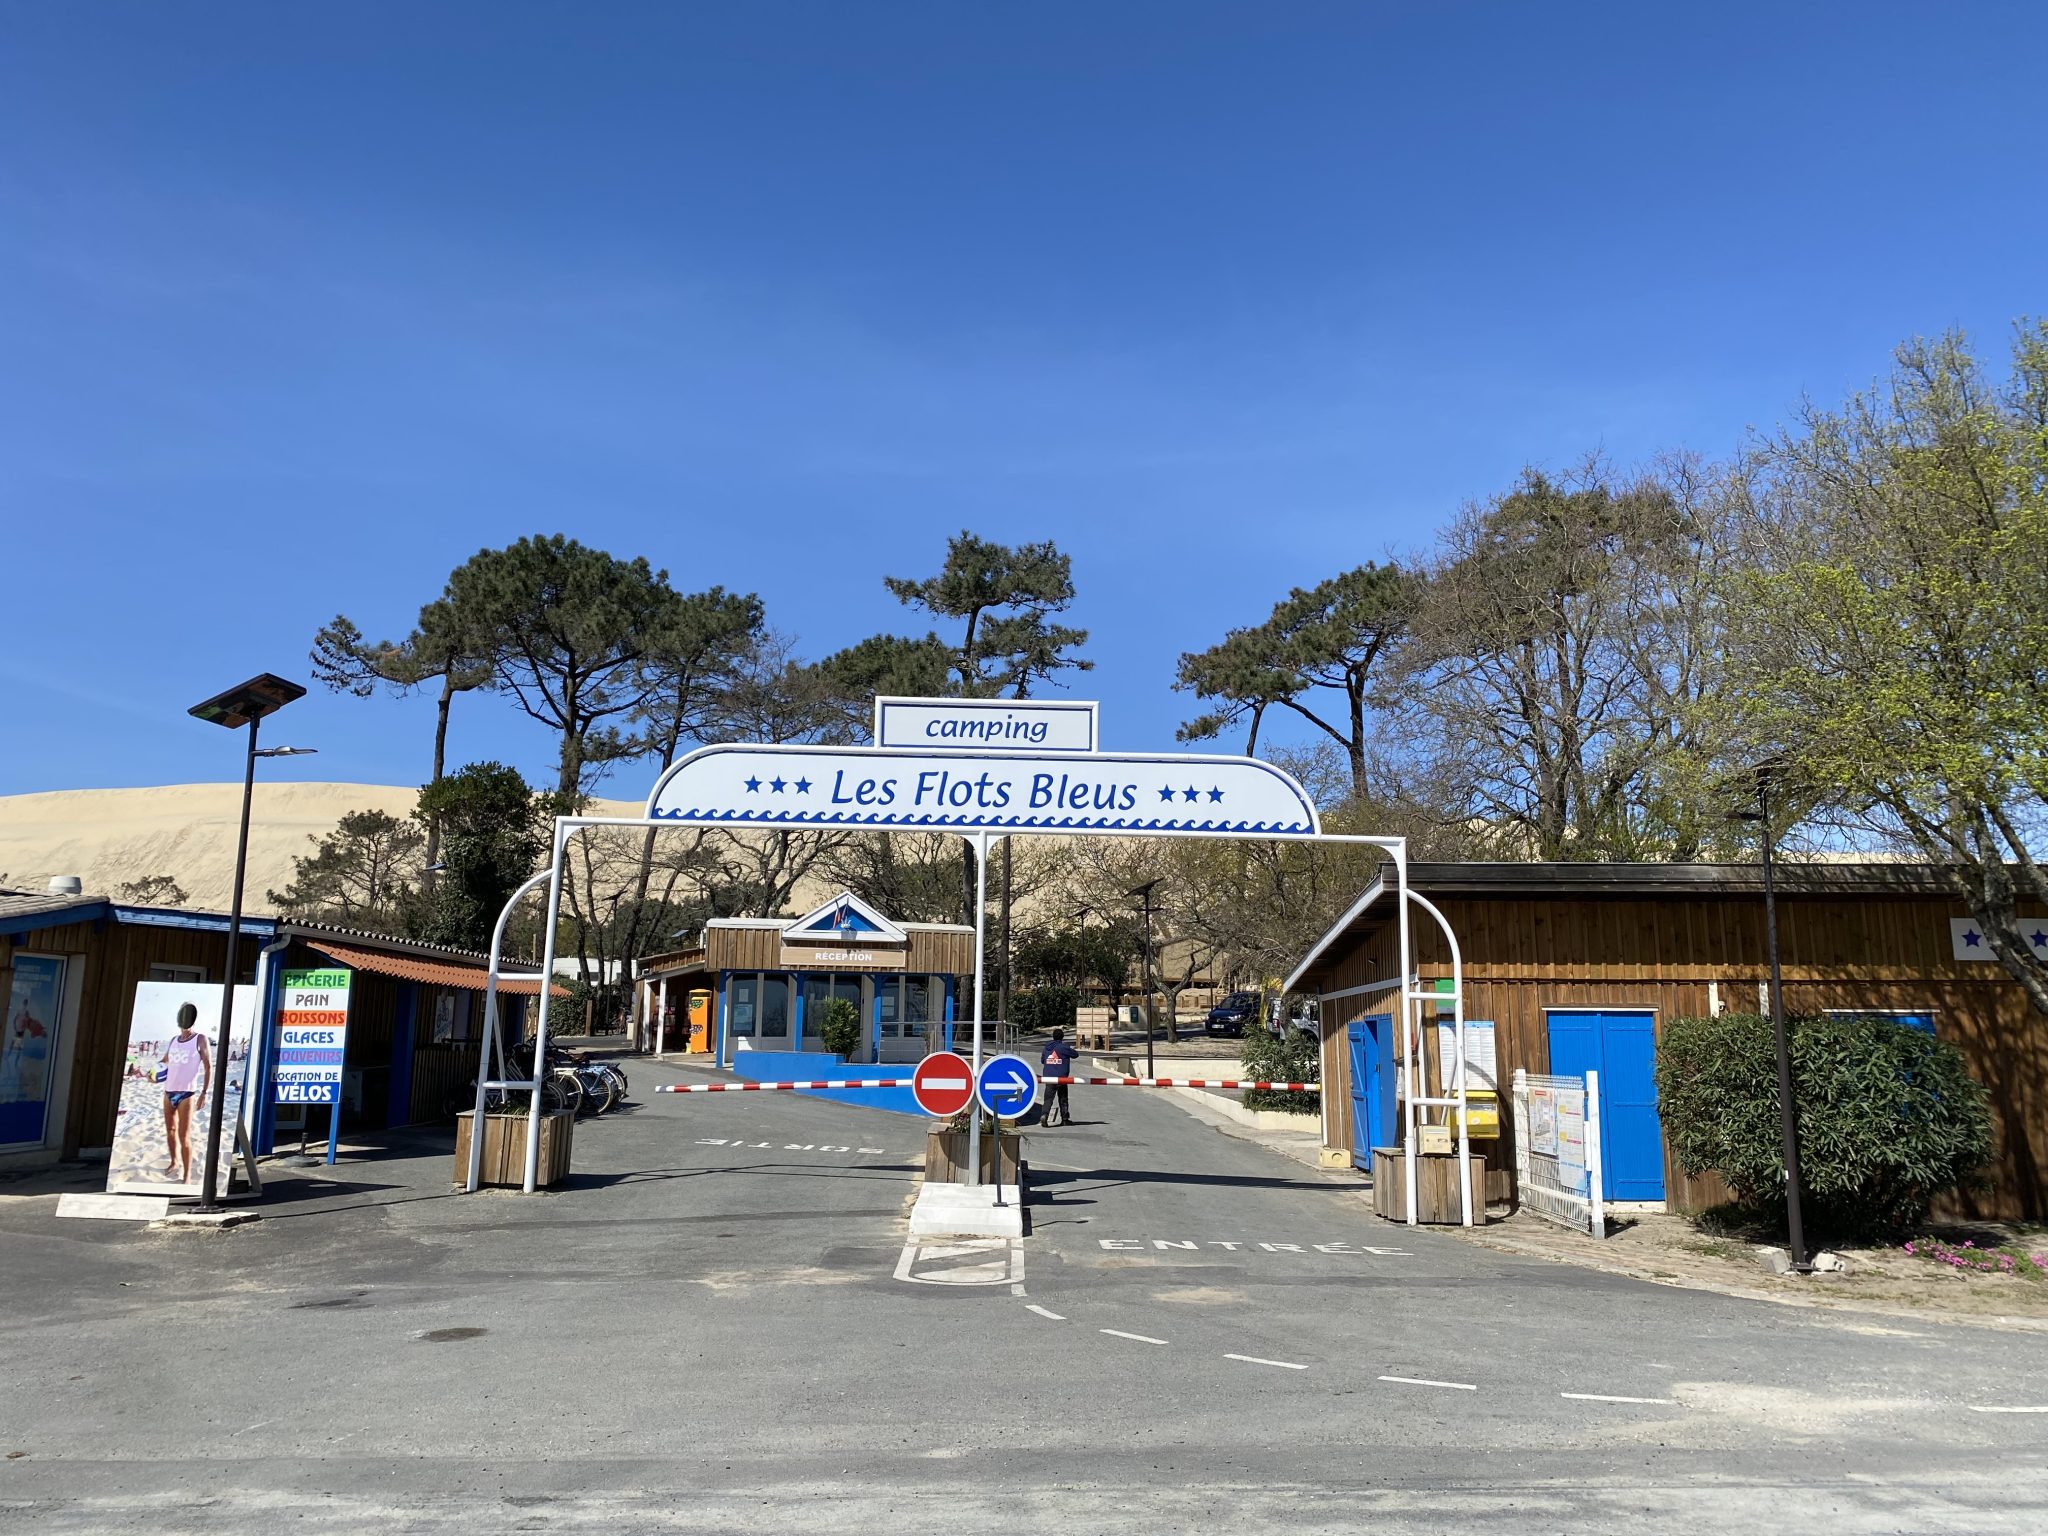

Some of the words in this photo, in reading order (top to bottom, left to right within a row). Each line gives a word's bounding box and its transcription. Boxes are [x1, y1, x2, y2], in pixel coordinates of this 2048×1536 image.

[925, 713, 1049, 743] camping
[831, 769, 898, 805] Les
[914, 771, 1012, 809] Flots
[1029, 774, 1138, 810] Bleus
[815, 952, 872, 961] RÉCEPTION
[285, 973, 345, 986] ÉPICERIE
[295, 994, 329, 1007] PAIN
[279, 1012, 345, 1025] BOISSONS
[284, 1032, 334, 1044] GLACES
[276, 1051, 342, 1063] SOUVENIRS
[273, 1072, 322, 1082] LOCATION
[324, 1073, 338, 1081] DE
[277, 1081, 332, 1101] VÉLOS
[693, 1138, 886, 1154] SORTIE
[1099, 1238, 1414, 1256] ENTRÉE
